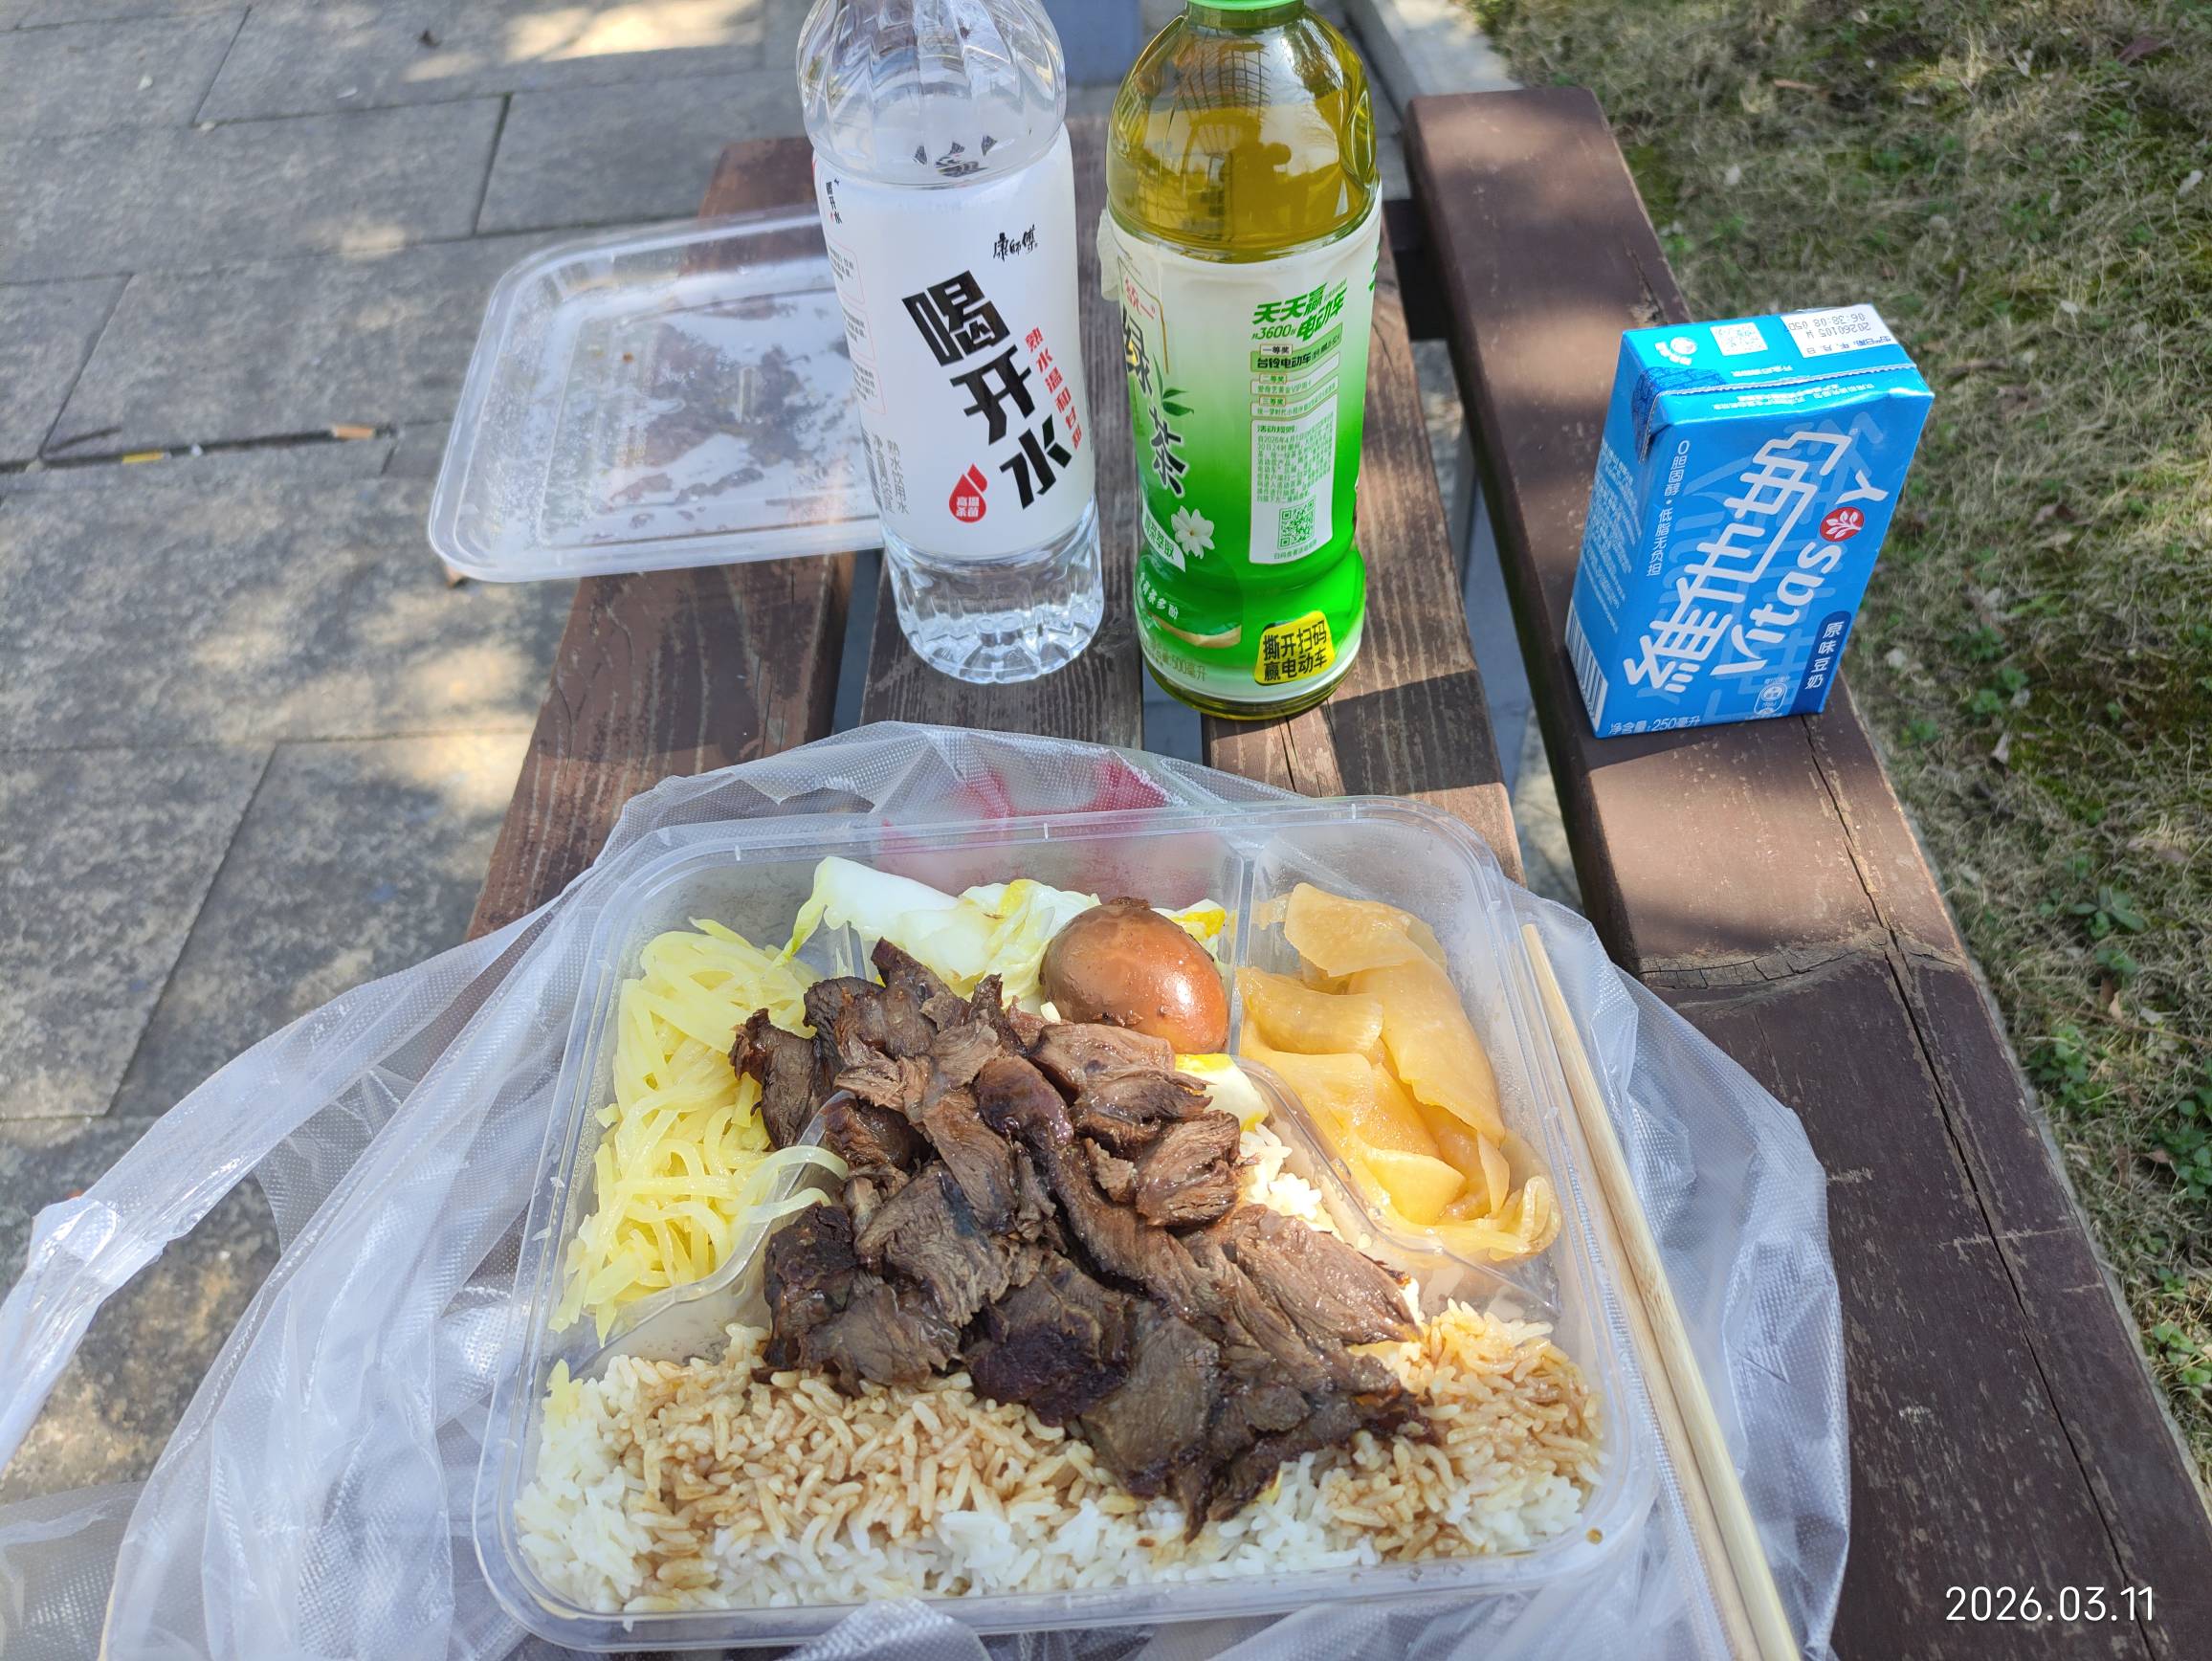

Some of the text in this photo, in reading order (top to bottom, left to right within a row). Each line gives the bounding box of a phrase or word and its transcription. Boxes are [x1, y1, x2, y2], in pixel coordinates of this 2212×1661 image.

[1252, 282, 1327, 325] 天天赢
[1296, 286, 1347, 342] 电动车
[1262, 345, 1290, 355] 一等奖
[1819, 321, 1871, 338] 20260105
[901, 269, 1073, 509] 喝开水
[1263, 619, 1327, 661] 撕开扫码
[1804, 620, 1846, 690] 原味豆奶
[1264, 647, 1327, 682] 赢电动车
